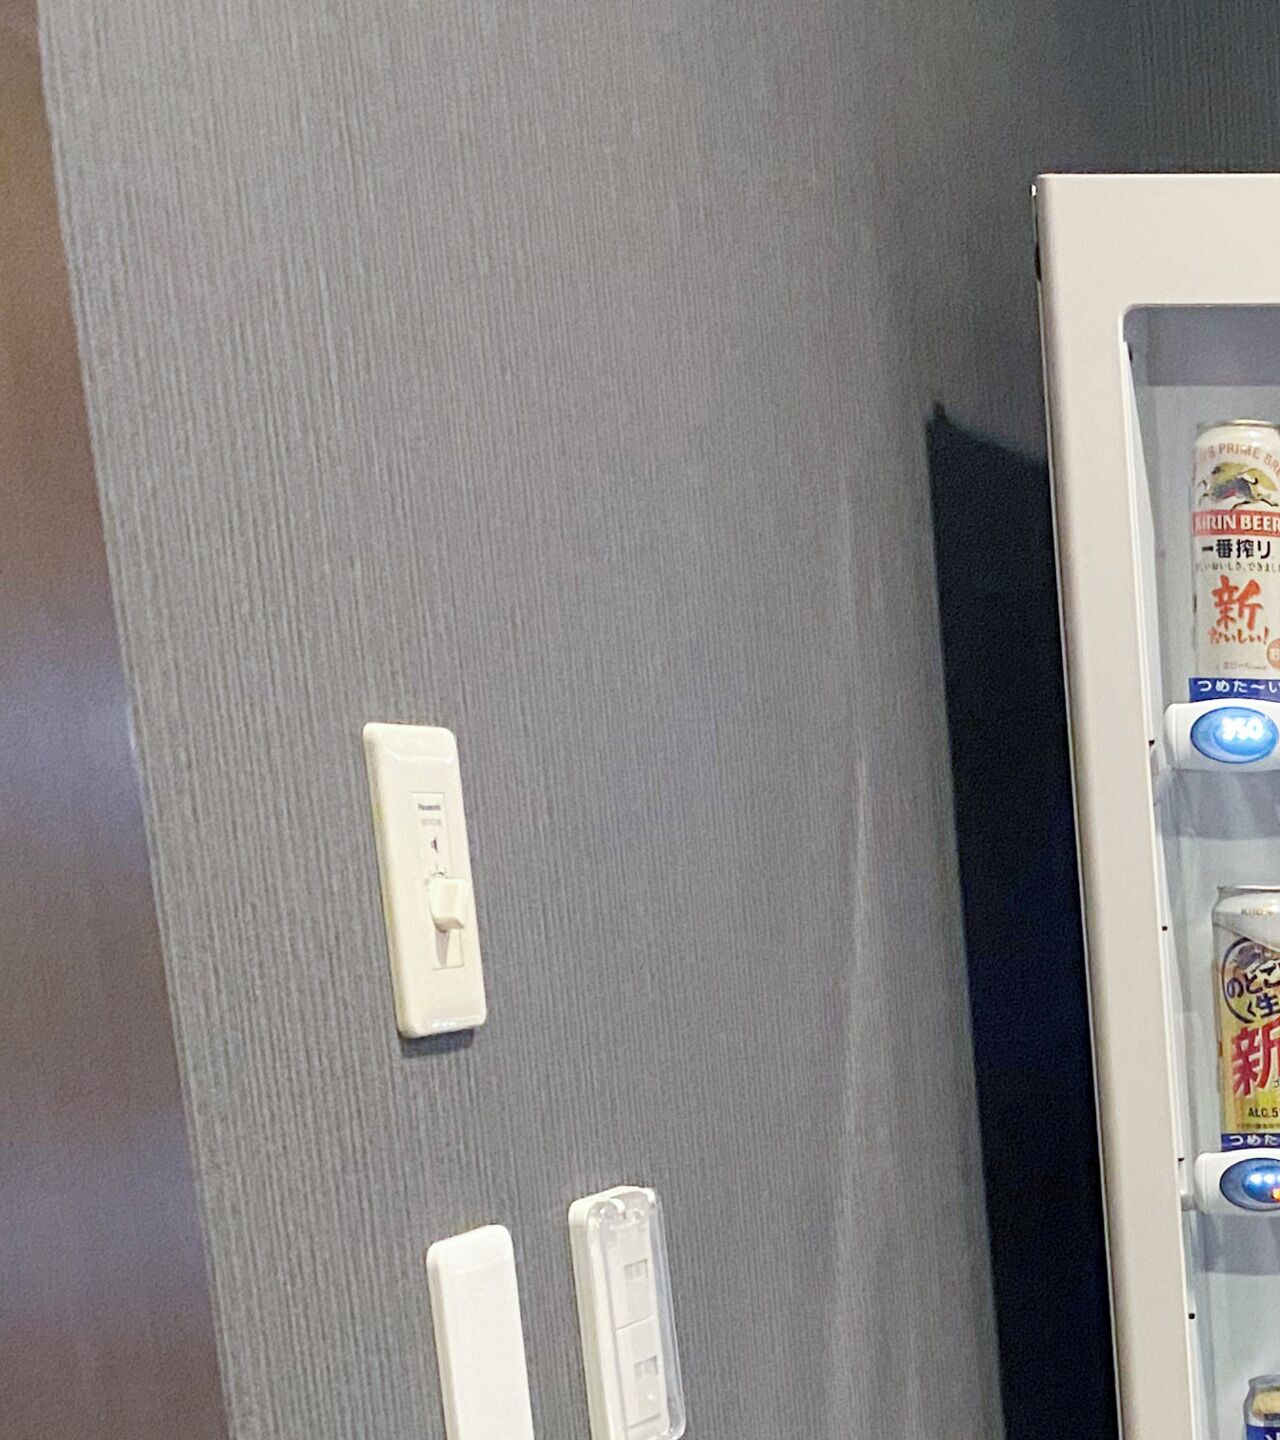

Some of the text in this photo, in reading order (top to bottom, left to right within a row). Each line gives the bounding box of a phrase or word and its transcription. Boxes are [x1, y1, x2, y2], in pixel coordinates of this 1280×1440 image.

[1201, 538, 1271, 560] 一番搾り
[1211, 575, 1264, 631] 新
[1222, 717, 1263, 740] 350
